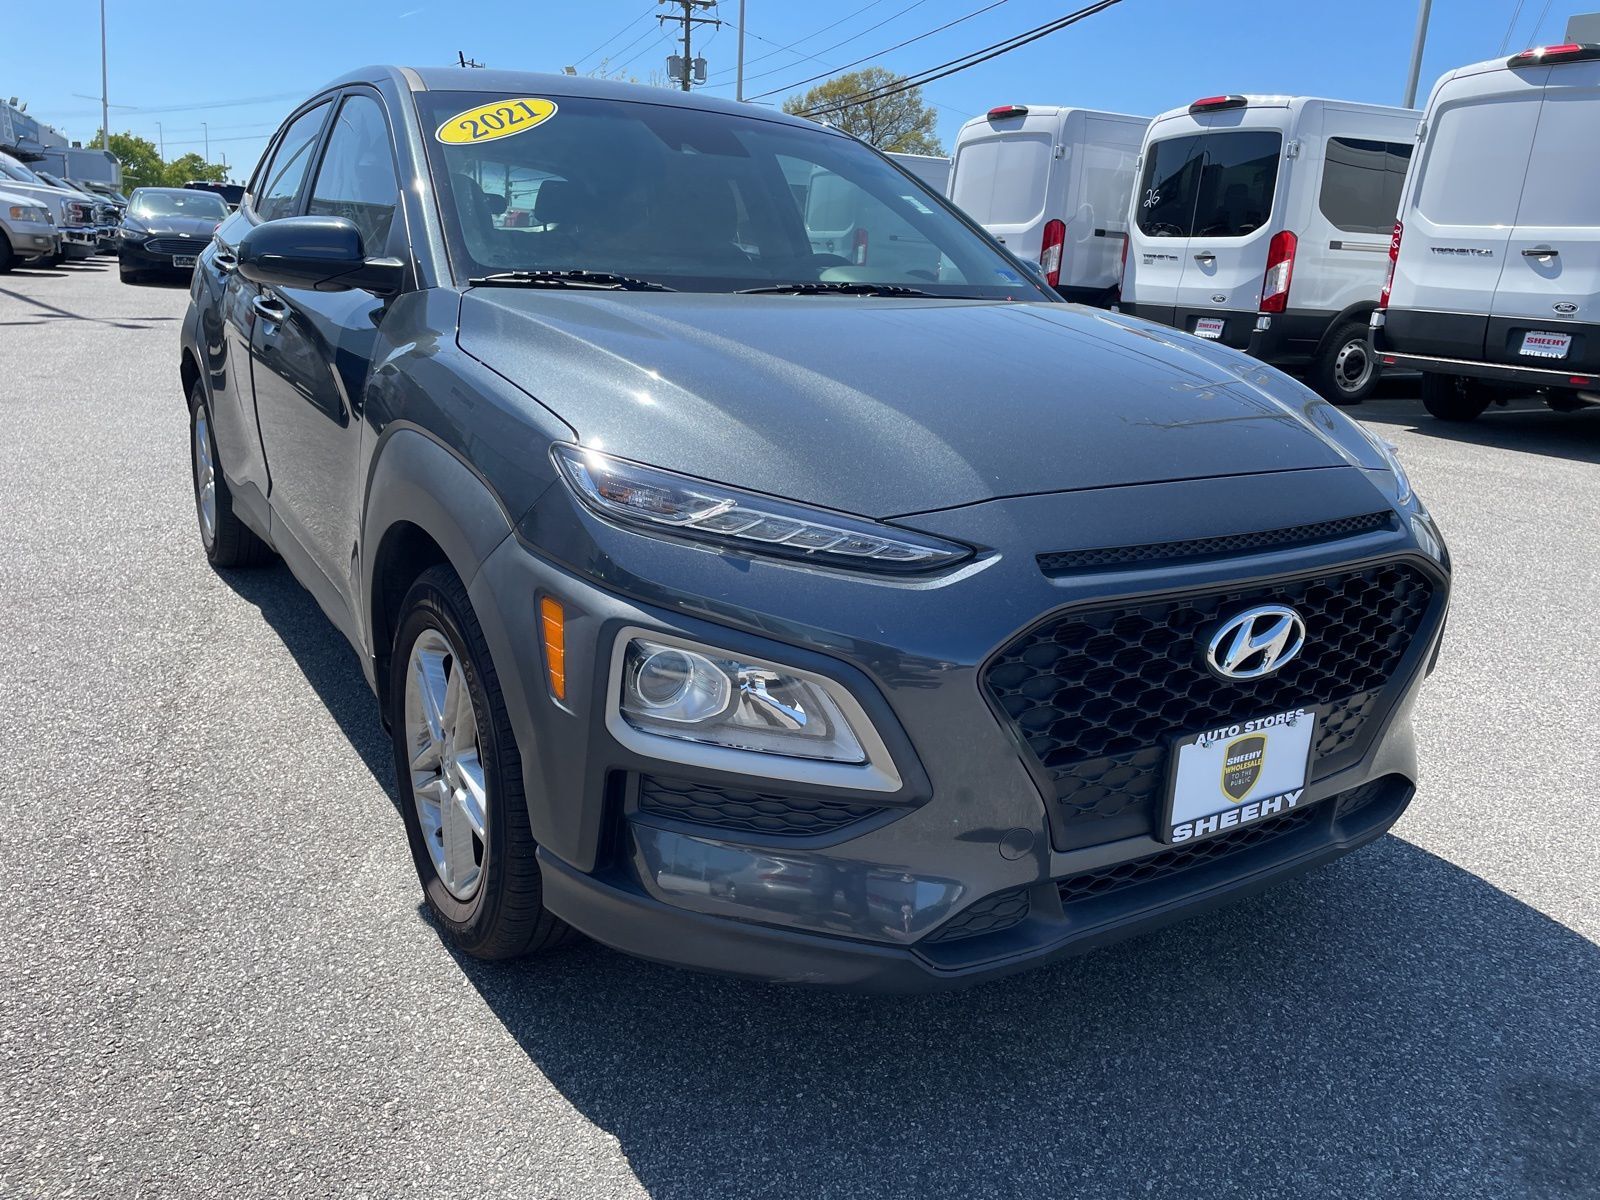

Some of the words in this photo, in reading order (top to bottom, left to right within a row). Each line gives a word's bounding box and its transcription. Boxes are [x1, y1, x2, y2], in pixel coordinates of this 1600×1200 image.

[459, 101, 542, 140] 2021
[1526, 336, 1567, 346] SHEEHY
[1195, 724, 1240, 746] AUTO
[1244, 708, 1305, 732] STORES
[1226, 750, 1262, 766] SHEEHY
[1224, 758, 1263, 775] WHOLESALE
[1241, 769, 1252, 777] THE
[1230, 777, 1251, 786] PUBLIC
[1171, 788, 1305, 843] SHEEHY
